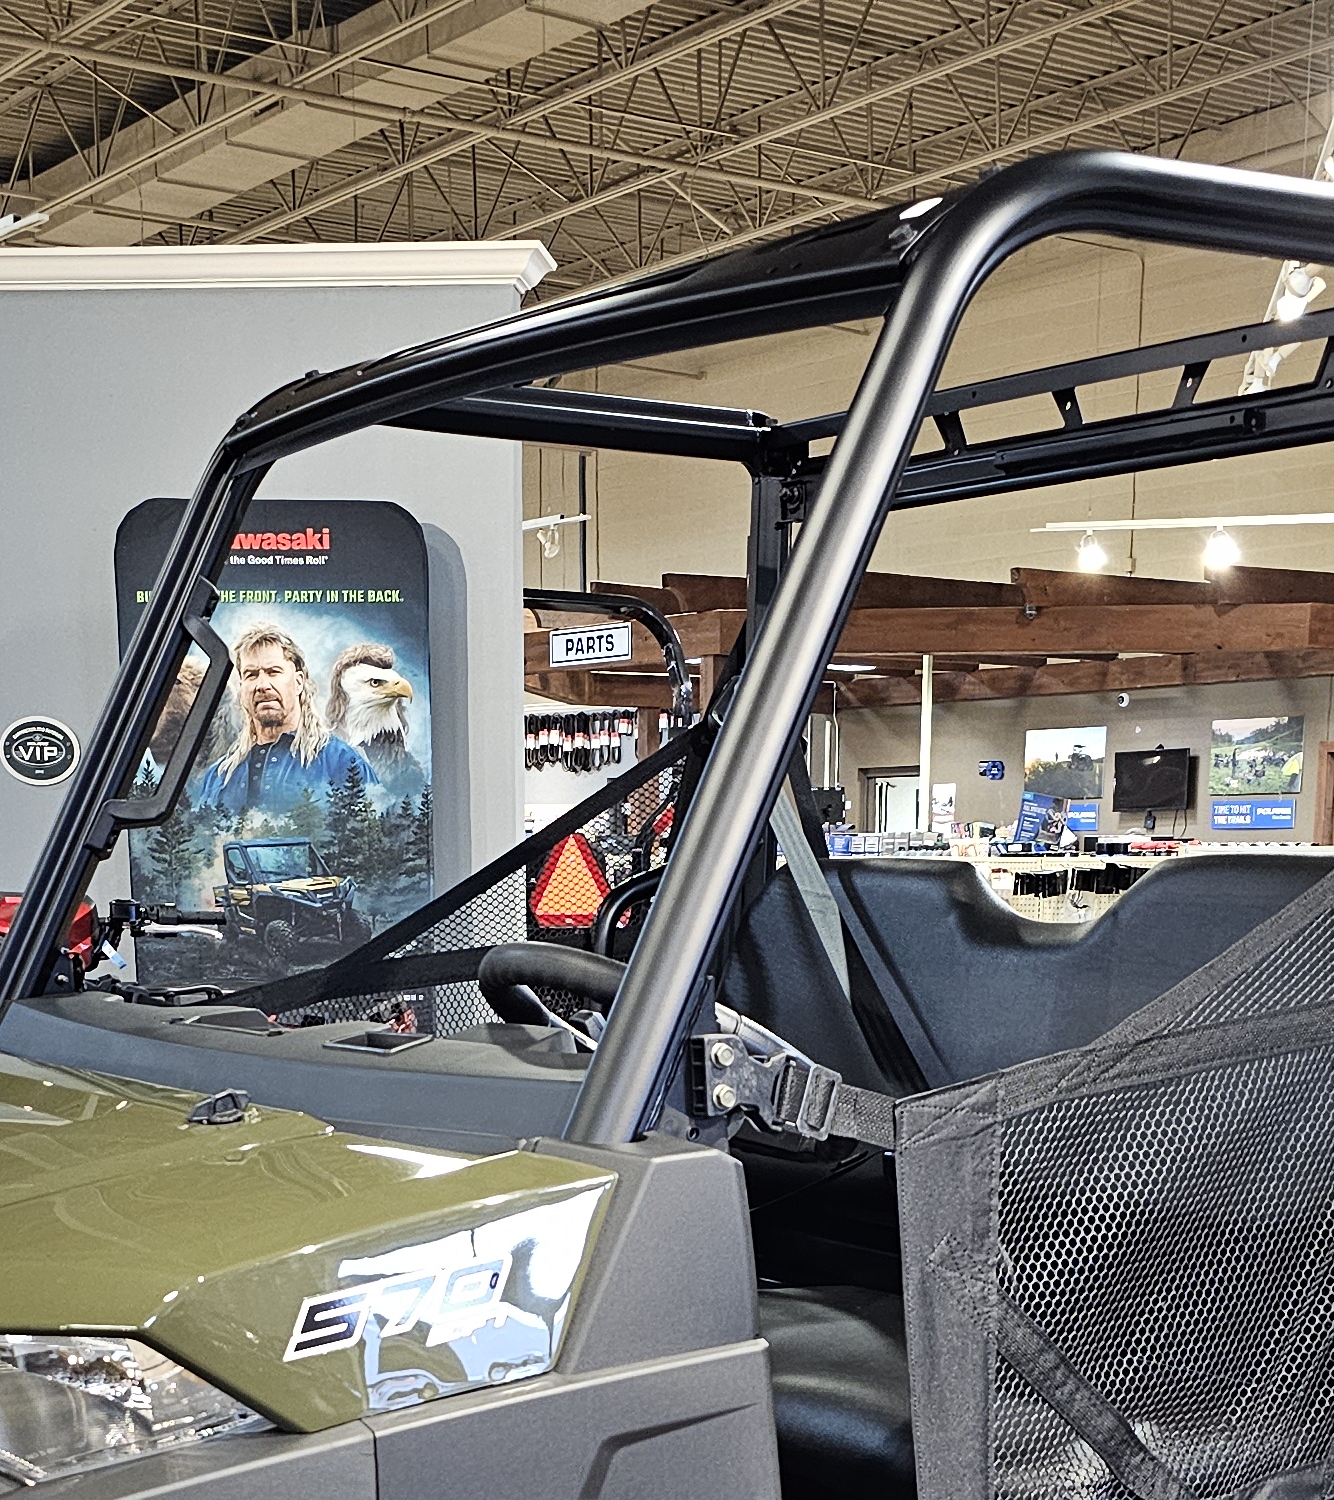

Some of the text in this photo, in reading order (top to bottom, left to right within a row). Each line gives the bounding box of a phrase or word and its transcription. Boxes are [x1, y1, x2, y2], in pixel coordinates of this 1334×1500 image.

[231, 527, 330, 550] wasaki
[248, 555, 273, 566] Good
[275, 555, 304, 566] Times
[217, 589, 405, 603] HE FRONT. PARTY IN THE BACK.
[565, 633, 615, 657] PARTS
[18, 745, 58, 762] VIP
